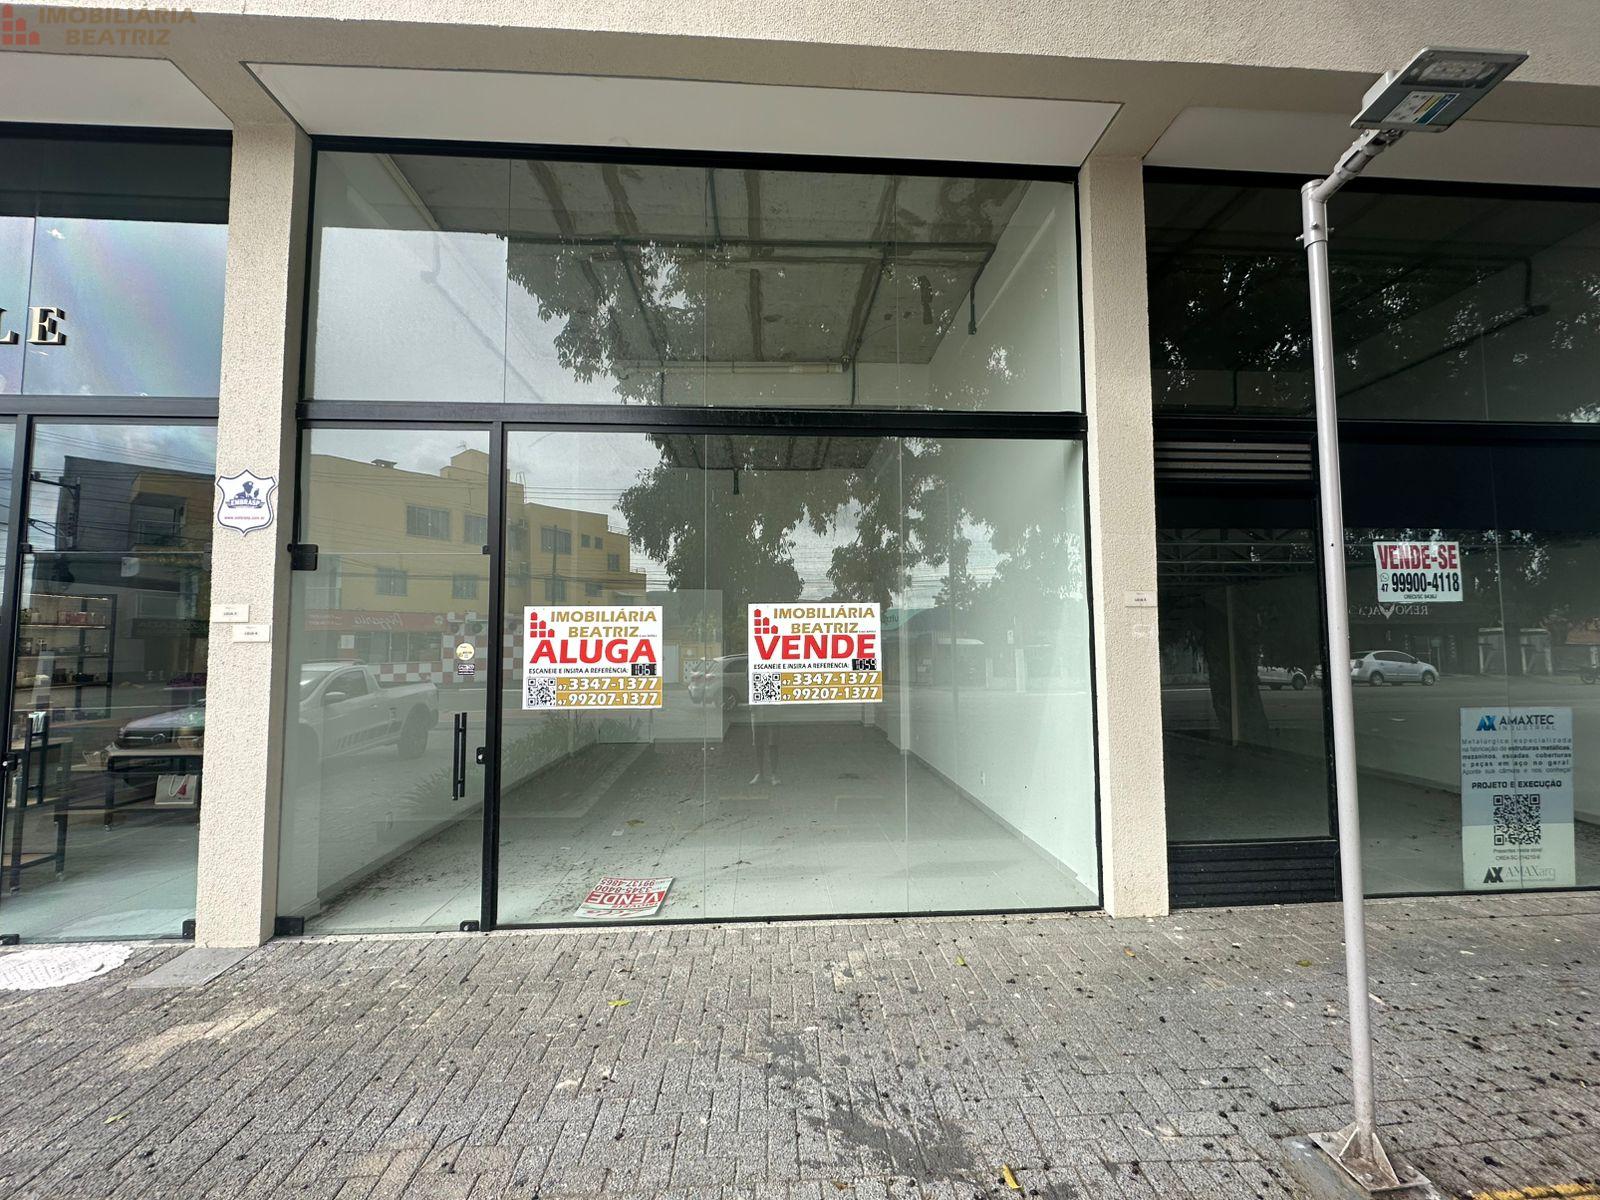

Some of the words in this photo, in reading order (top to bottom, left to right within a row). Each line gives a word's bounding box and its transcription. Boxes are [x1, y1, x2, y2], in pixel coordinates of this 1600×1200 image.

[1377, 544, 1458, 569] VENDE-SE
[1381, 583, 1389, 592] 47
[1392, 572, 1460, 592] 99900-4118
[550, 608, 657, 622] IMOBILIÁRIA
[773, 605, 875, 619] IMOBILIÁRIA
[568, 626, 640, 638] BEATRIZ
[791, 622, 859, 634] BEATRIZ
[529, 638, 657, 664] ALUGA
[754, 634, 876, 660] VENDE
[568, 678, 658, 691] 3347-1377
[792, 672, 878, 685] 3347-1377
[568, 692, 658, 705] 99207-1377
[792, 687, 878, 700] 99207-1377
[1499, 714, 1554, 725] AMAXTEC
[1471, 781, 1508, 789] PROJETO
[1518, 779, 1562, 789] EXECUÇÃO
[588, 892, 659, 905] VENDE
